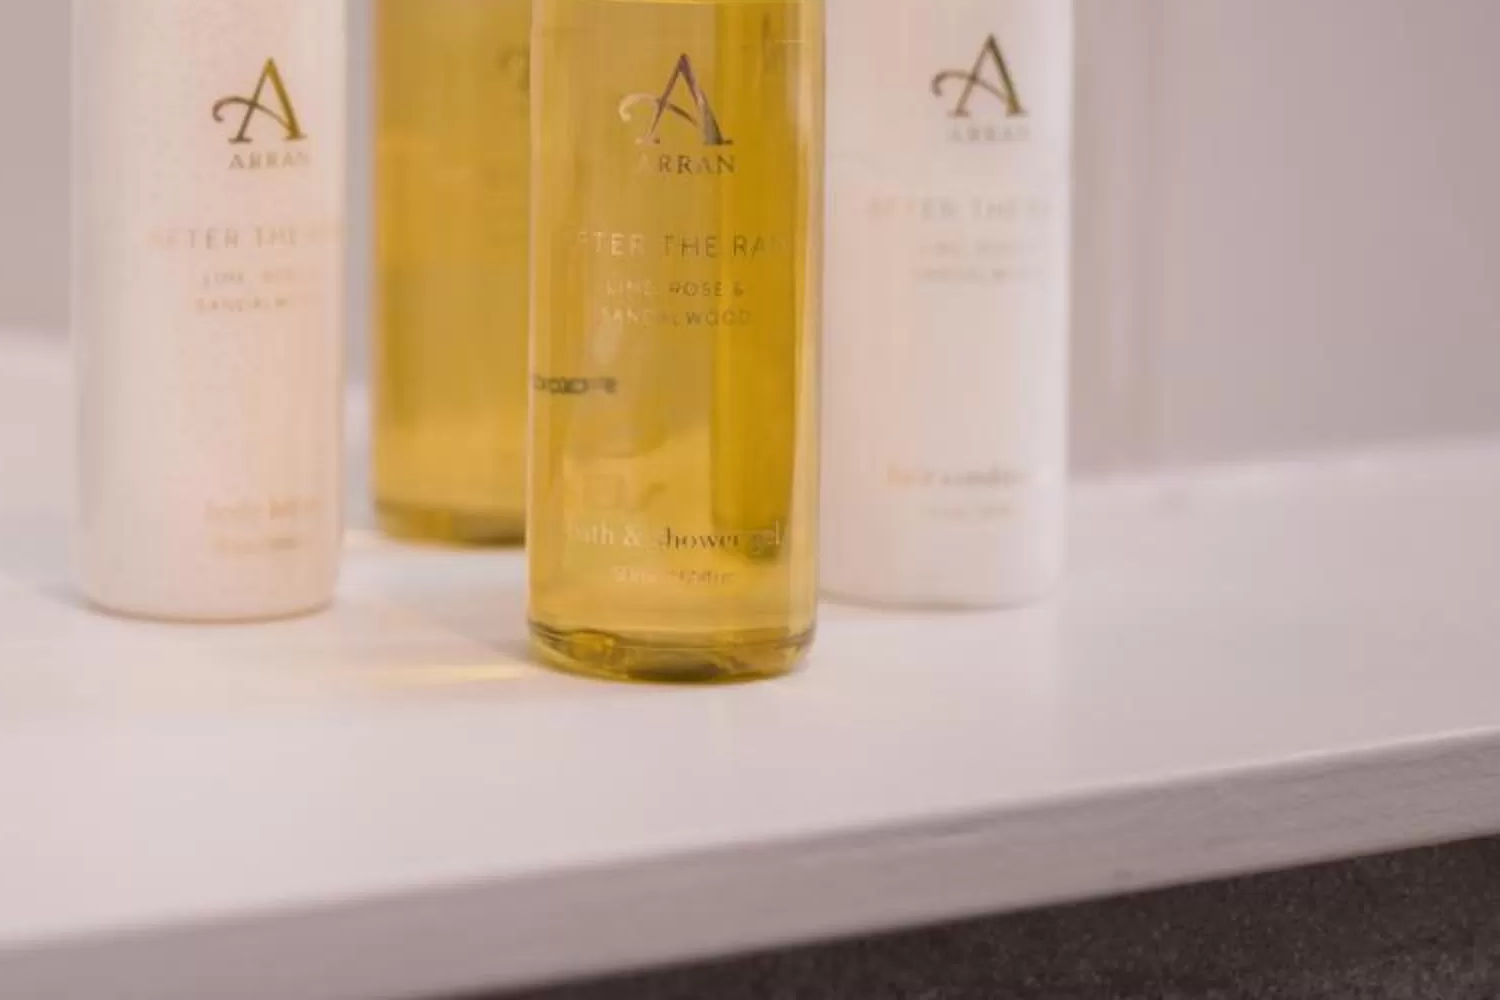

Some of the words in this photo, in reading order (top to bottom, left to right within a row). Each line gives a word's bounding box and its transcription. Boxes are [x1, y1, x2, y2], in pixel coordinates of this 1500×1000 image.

[211, 56, 308, 144] A
[576, 230, 646, 258] FTER
[663, 233, 718, 258] THE
